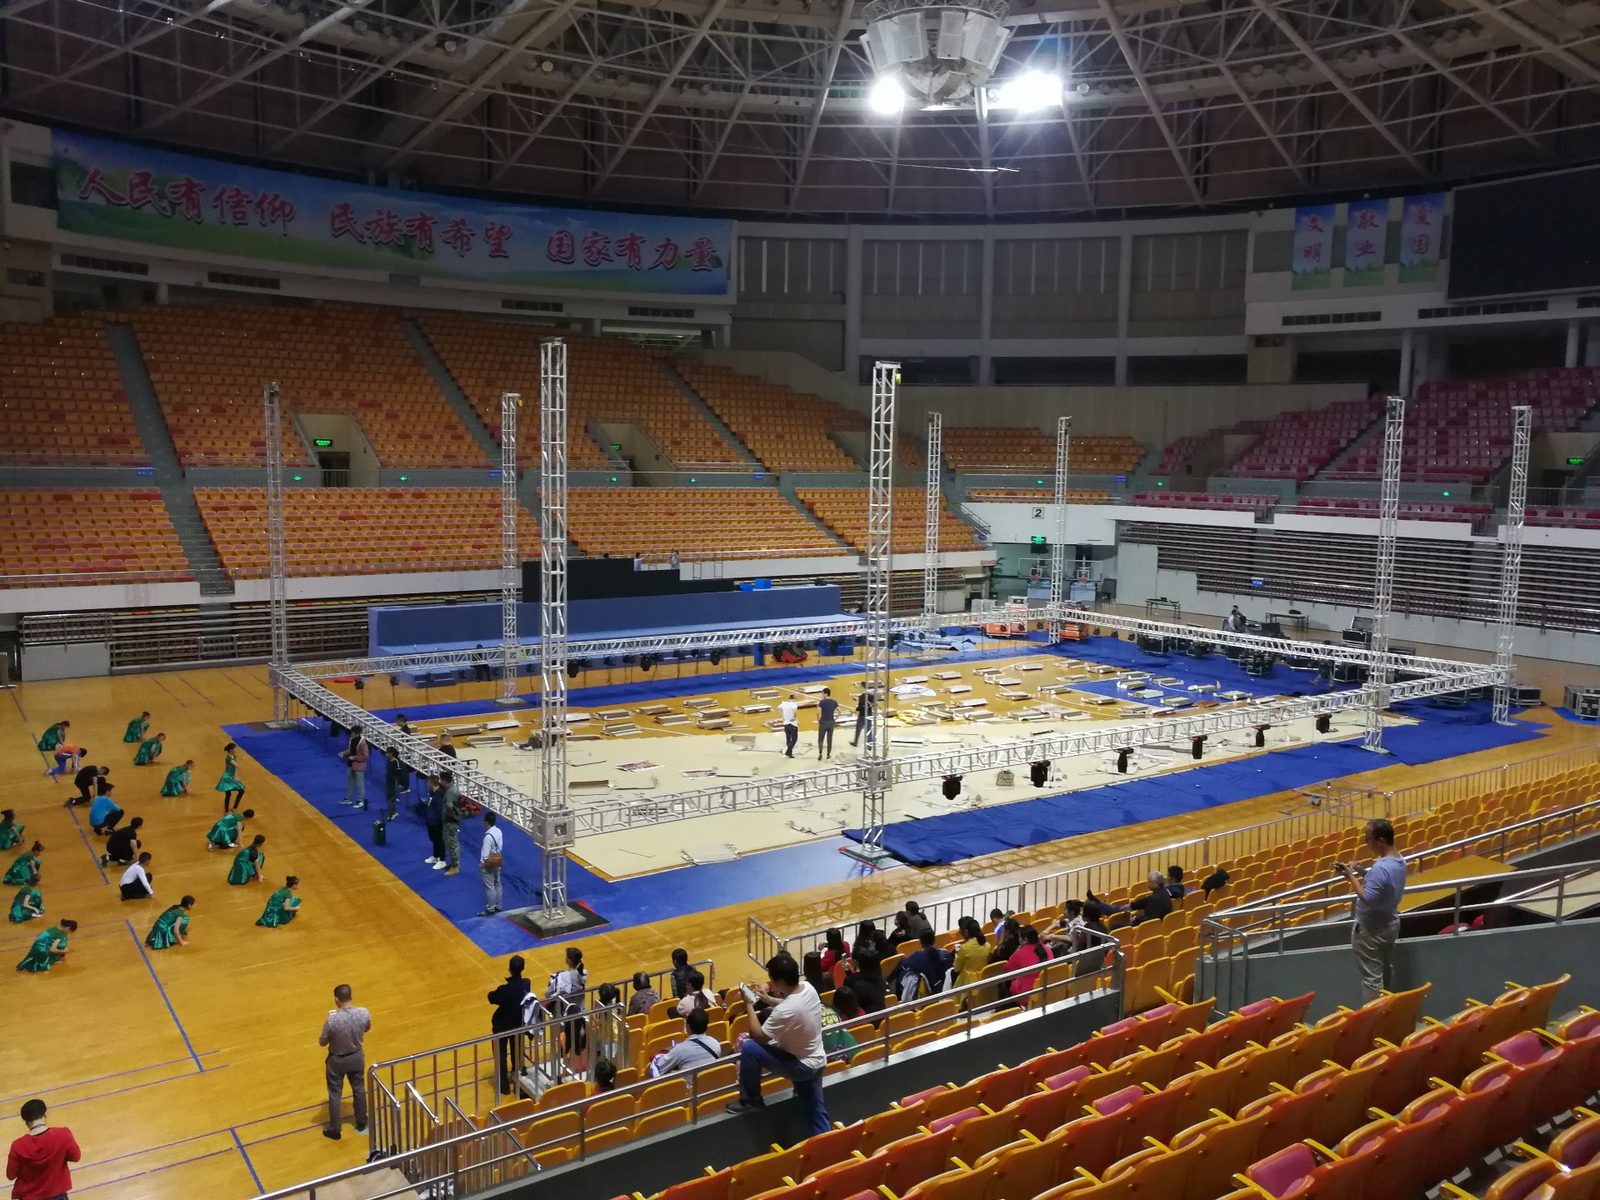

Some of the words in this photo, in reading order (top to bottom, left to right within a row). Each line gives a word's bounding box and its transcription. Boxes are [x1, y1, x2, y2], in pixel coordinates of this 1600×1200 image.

[79, 168, 296, 236] 人民有信仰
[331, 203, 513, 258] 民族有希望
[547, 229, 716, 272] 国家有力量
[1303, 215, 1324, 263] 文明
[1355, 209, 1379, 258] 敬业
[1411, 203, 1433, 255] 爱国
[1034, 508, 1042, 518] 2
